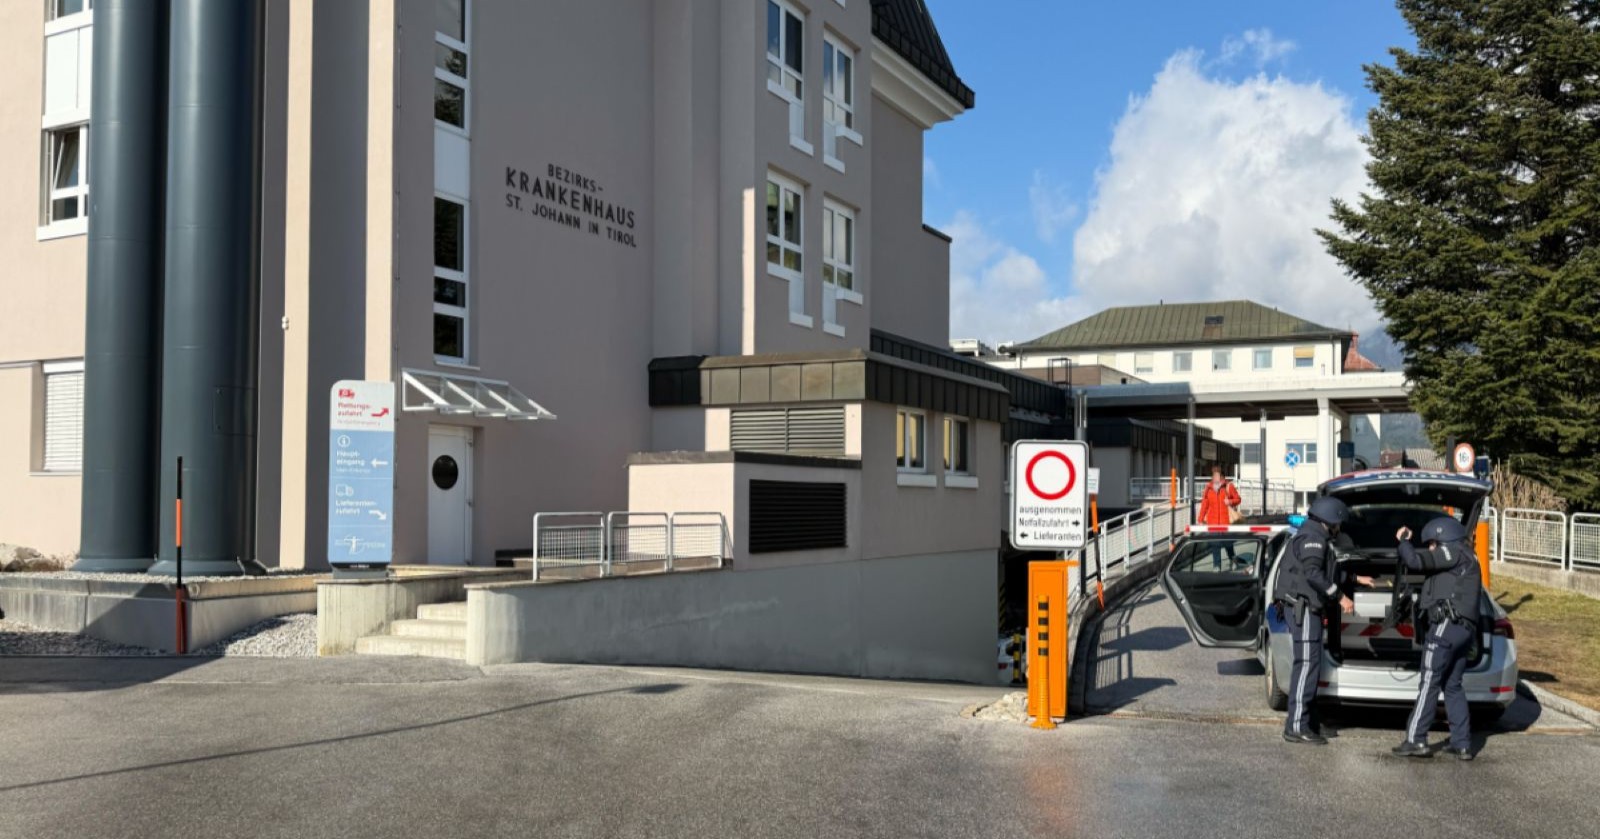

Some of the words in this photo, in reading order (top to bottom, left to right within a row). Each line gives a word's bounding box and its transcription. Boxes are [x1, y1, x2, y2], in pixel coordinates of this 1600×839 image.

[547, 163, 603, 193] BEZIRKS-
[506, 166, 635, 229] KRANKENHAUS
[506, 193, 523, 211] ST.
[532, 203, 580, 229] JOHANN
[588, 221, 599, 235] IN
[606, 226, 637, 248] TIROL
[1019, 506, 1082, 515] ausgenommen
[1019, 518, 1070, 528] Notfallzufahrt
[1033, 531, 1082, 542] Lieferanten
